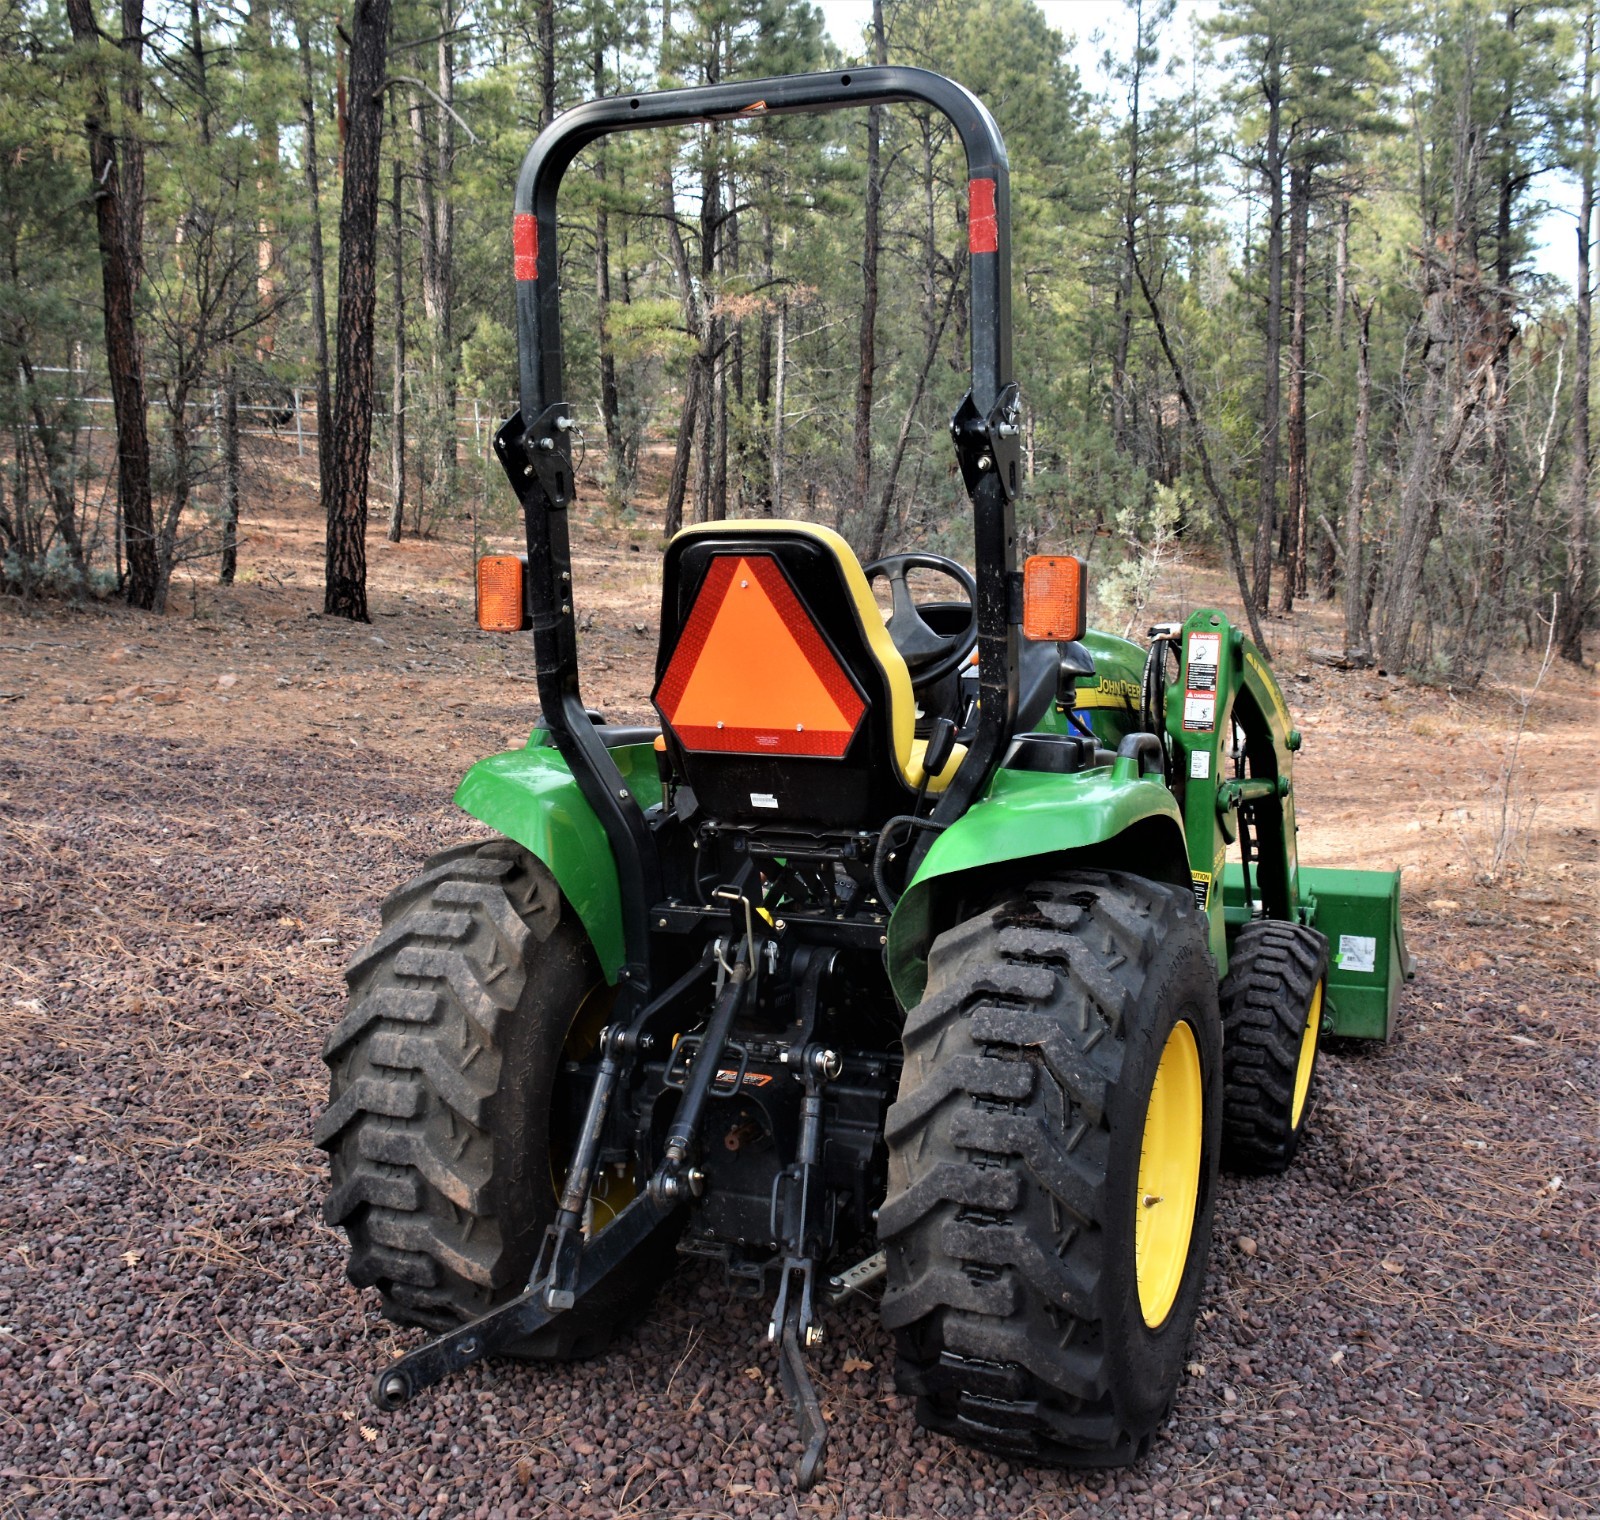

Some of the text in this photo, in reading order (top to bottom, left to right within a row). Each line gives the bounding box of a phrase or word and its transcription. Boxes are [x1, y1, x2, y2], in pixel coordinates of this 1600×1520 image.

[1097, 675, 1141, 699] JOHN DEER
[1192, 872, 1210, 881] UTION
